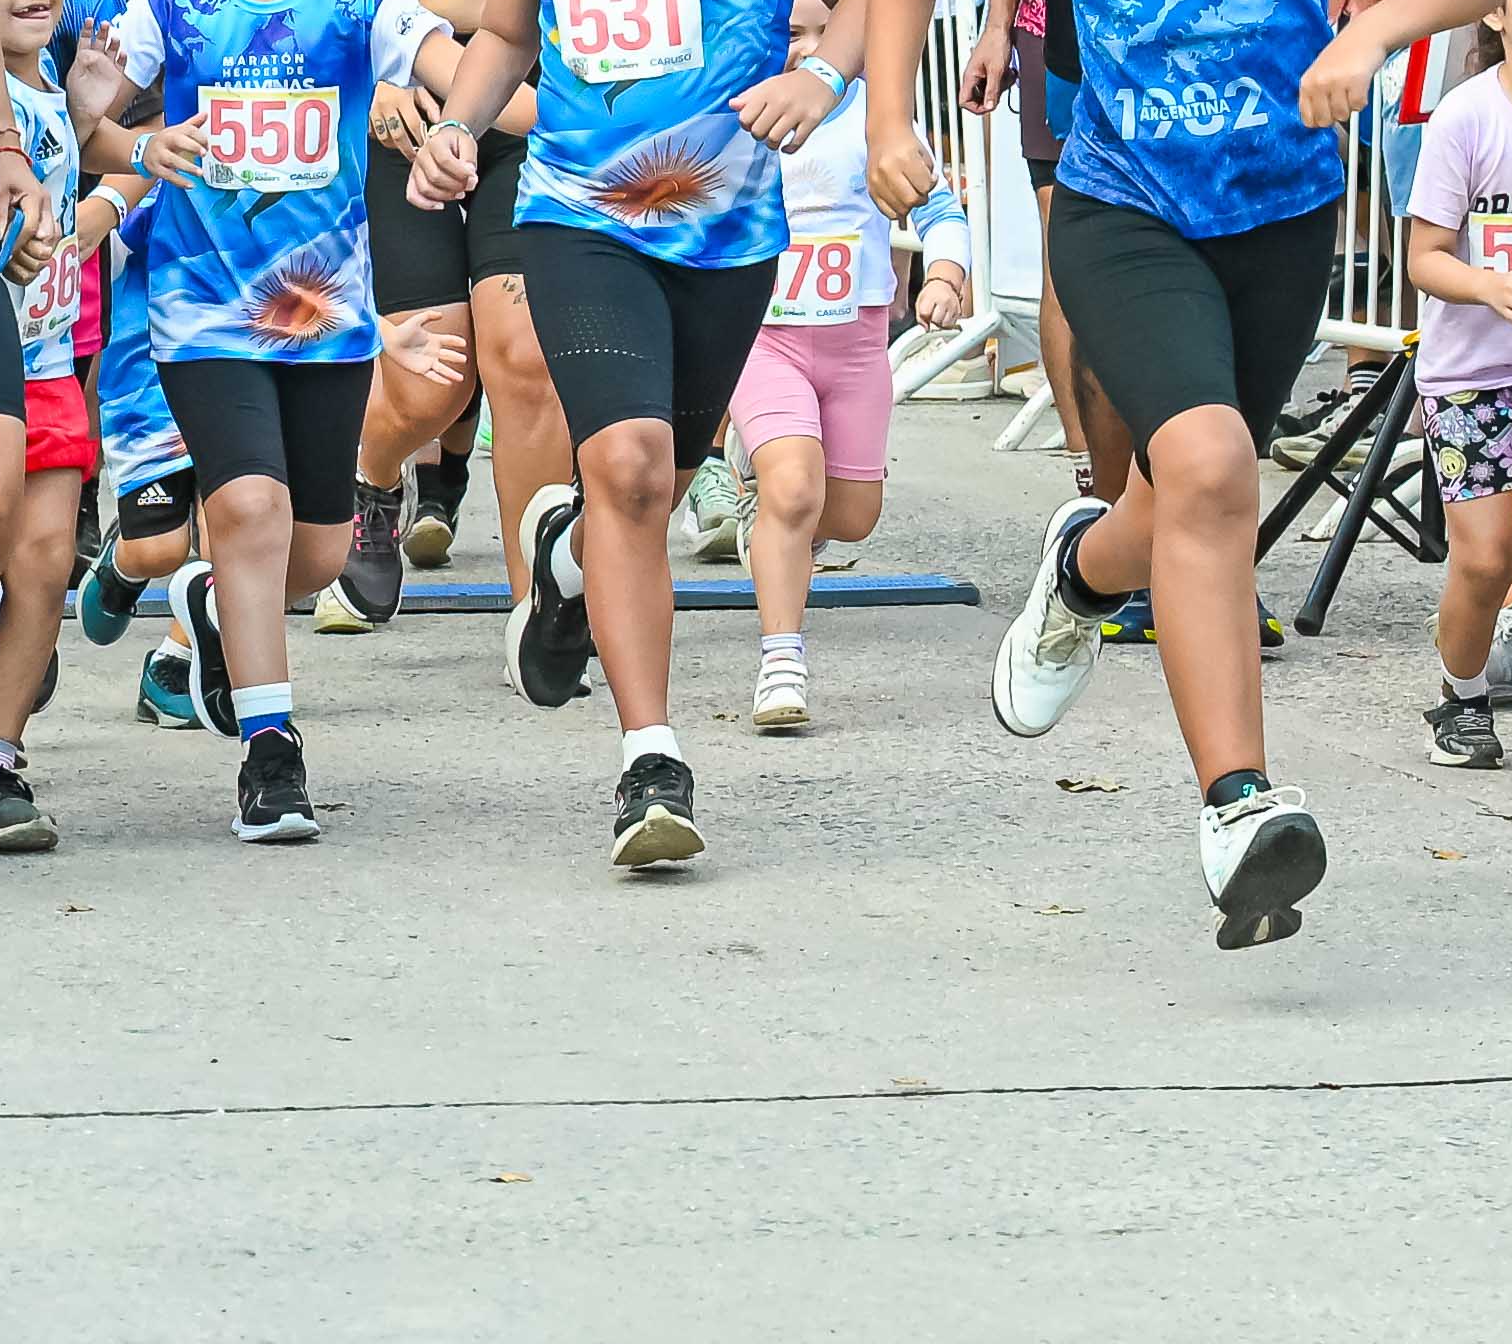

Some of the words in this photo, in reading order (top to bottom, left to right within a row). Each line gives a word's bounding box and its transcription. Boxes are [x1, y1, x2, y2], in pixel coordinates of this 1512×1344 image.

[222, 52, 304, 67] MARATÓN
[287, 66, 303, 75] DE
[650, 52, 692, 67] CARUSO
[1114, 76, 1269, 142] 1982
[1140, 98, 1232, 122] ARGENTINA
[210, 99, 331, 165] 550
[29, 243, 82, 319] 36
[773, 243, 852, 301] 78
